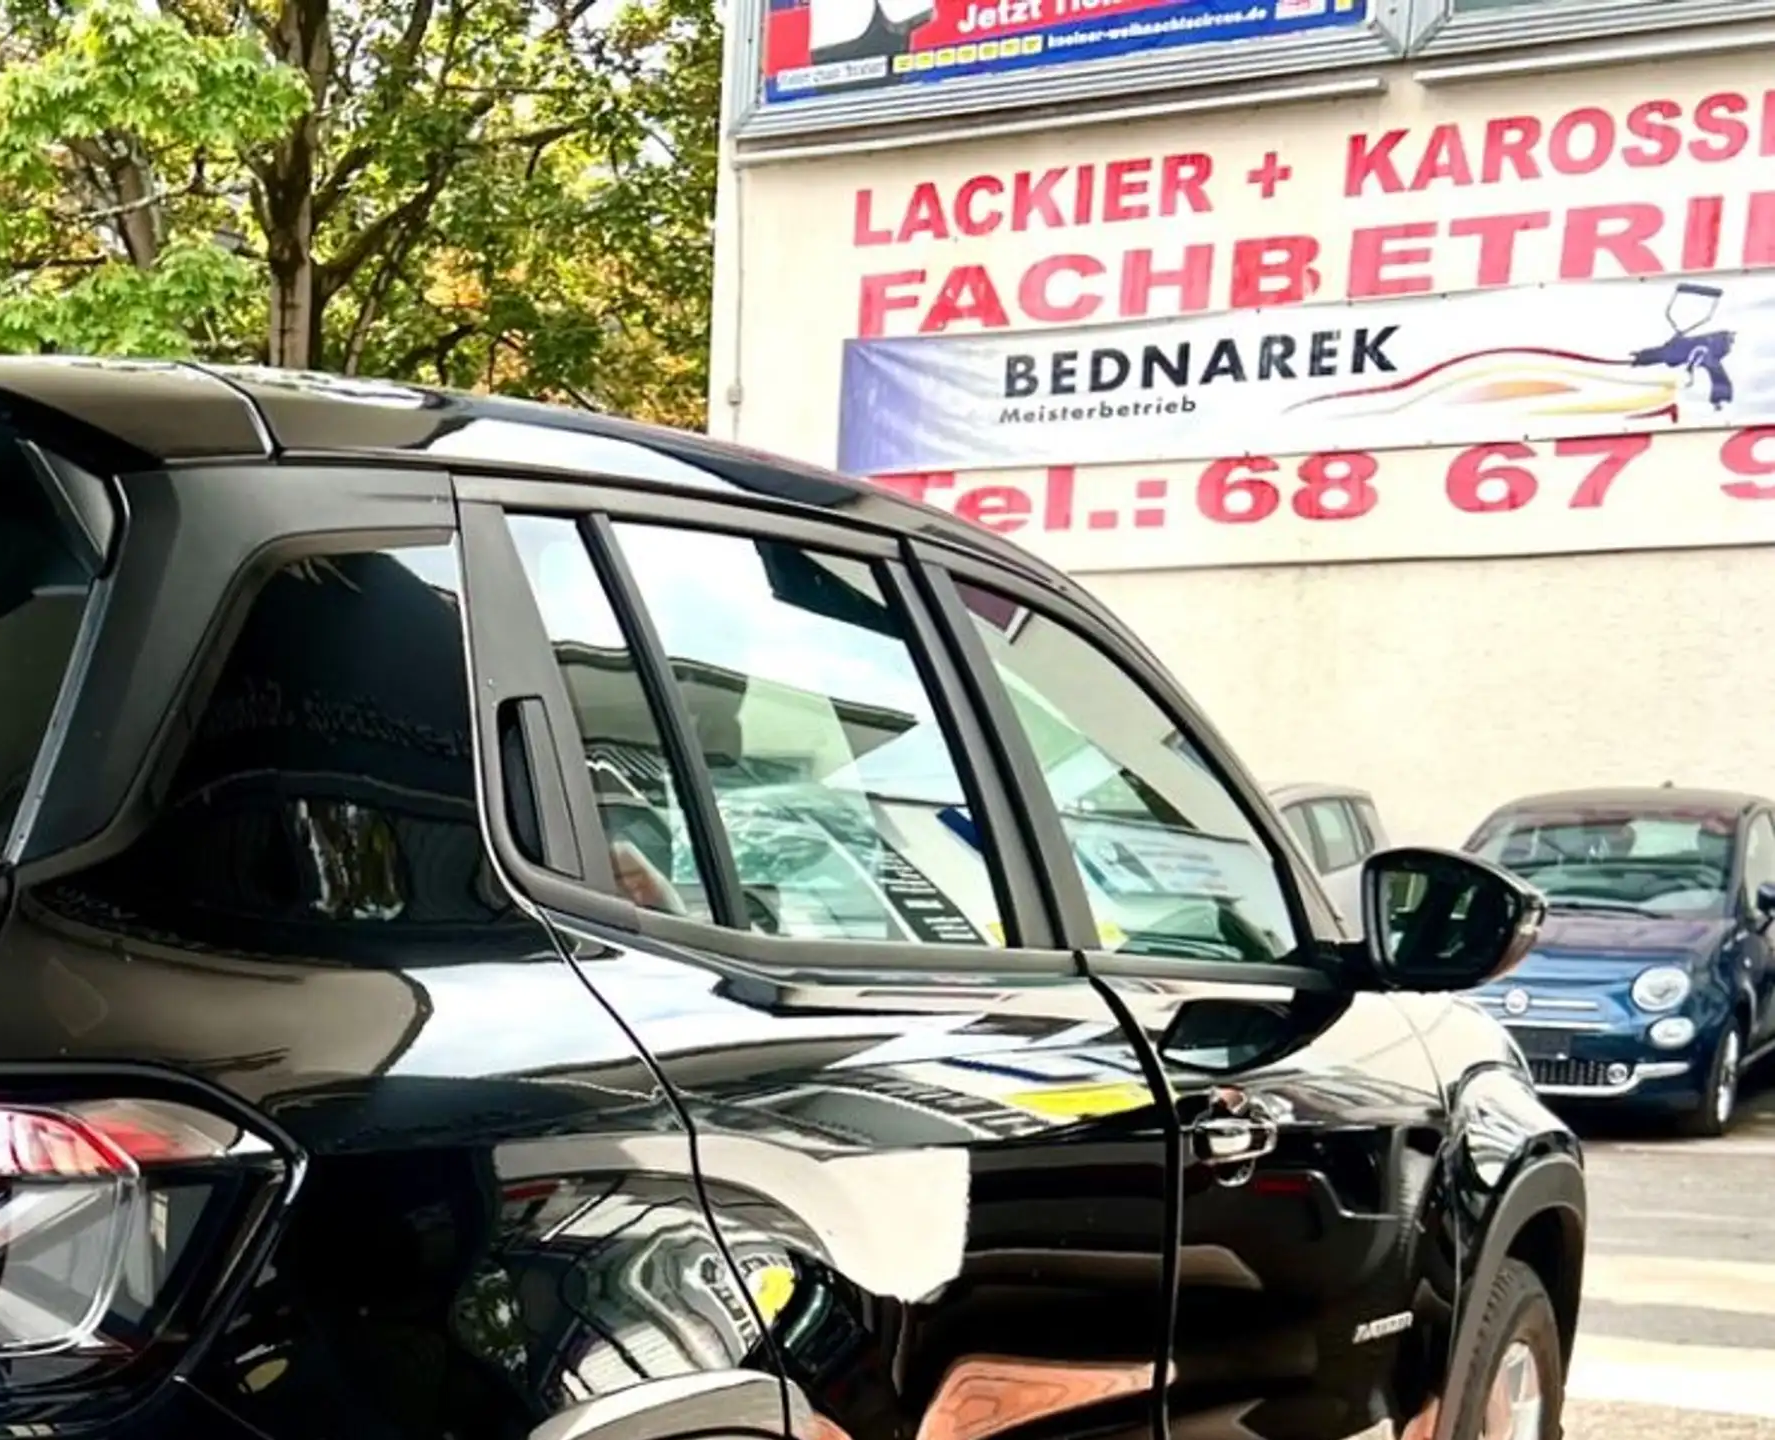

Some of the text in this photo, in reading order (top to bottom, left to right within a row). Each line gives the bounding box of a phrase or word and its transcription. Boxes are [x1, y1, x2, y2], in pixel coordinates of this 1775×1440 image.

[852, 86, 1775, 247] LACKIER + KAROSS
[1002, 325, 1401, 398] BEDNAREK
[999, 399, 1197, 424] Meisterbetrieb
[1194, 450, 1380, 525] 68
[1444, 432, 1653, 514] 67
